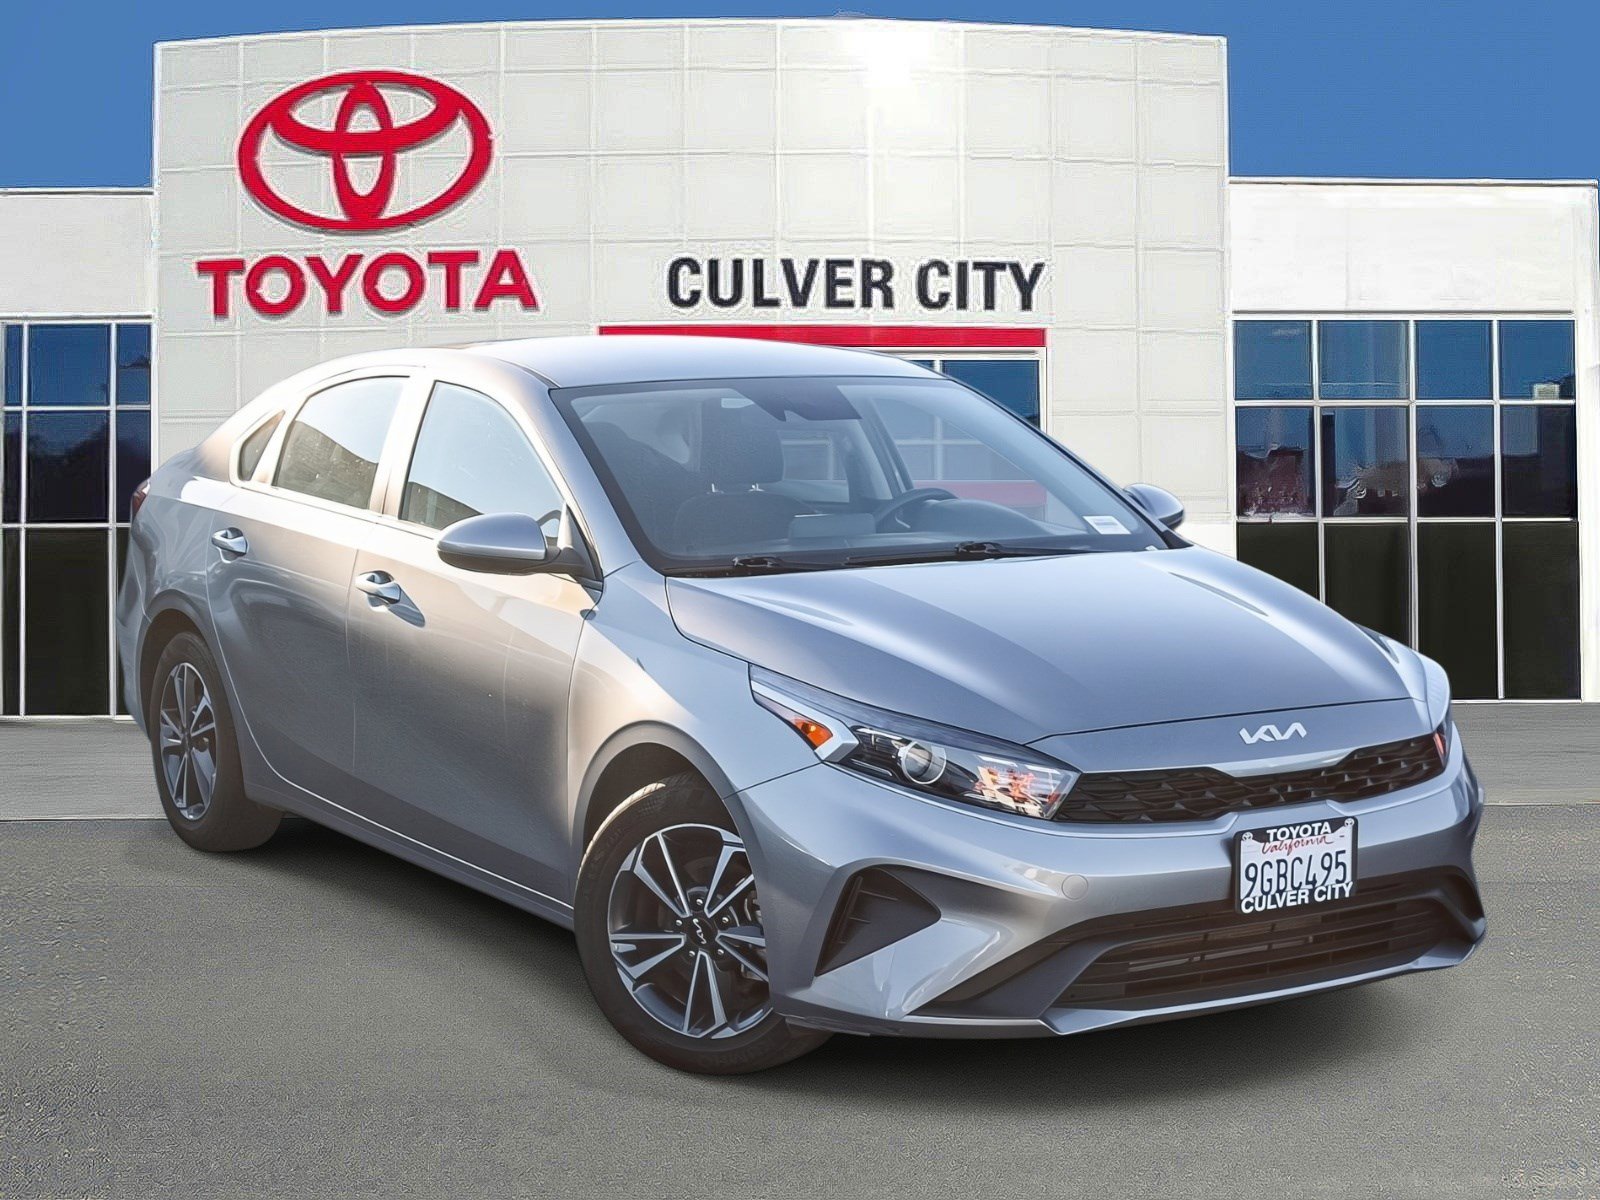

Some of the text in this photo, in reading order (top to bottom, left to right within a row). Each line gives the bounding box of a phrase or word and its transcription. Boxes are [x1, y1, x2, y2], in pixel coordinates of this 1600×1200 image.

[197, 249, 537, 318] TOYOTA
[668, 257, 1045, 311] CULVER CITY
[1239, 722, 1307, 744] KIA
[1261, 835, 1334, 856] California
[1266, 821, 1332, 843] TOYOTA
[1244, 850, 1347, 900] 9GBC495
[1241, 881, 1353, 914] CULVER CITY
